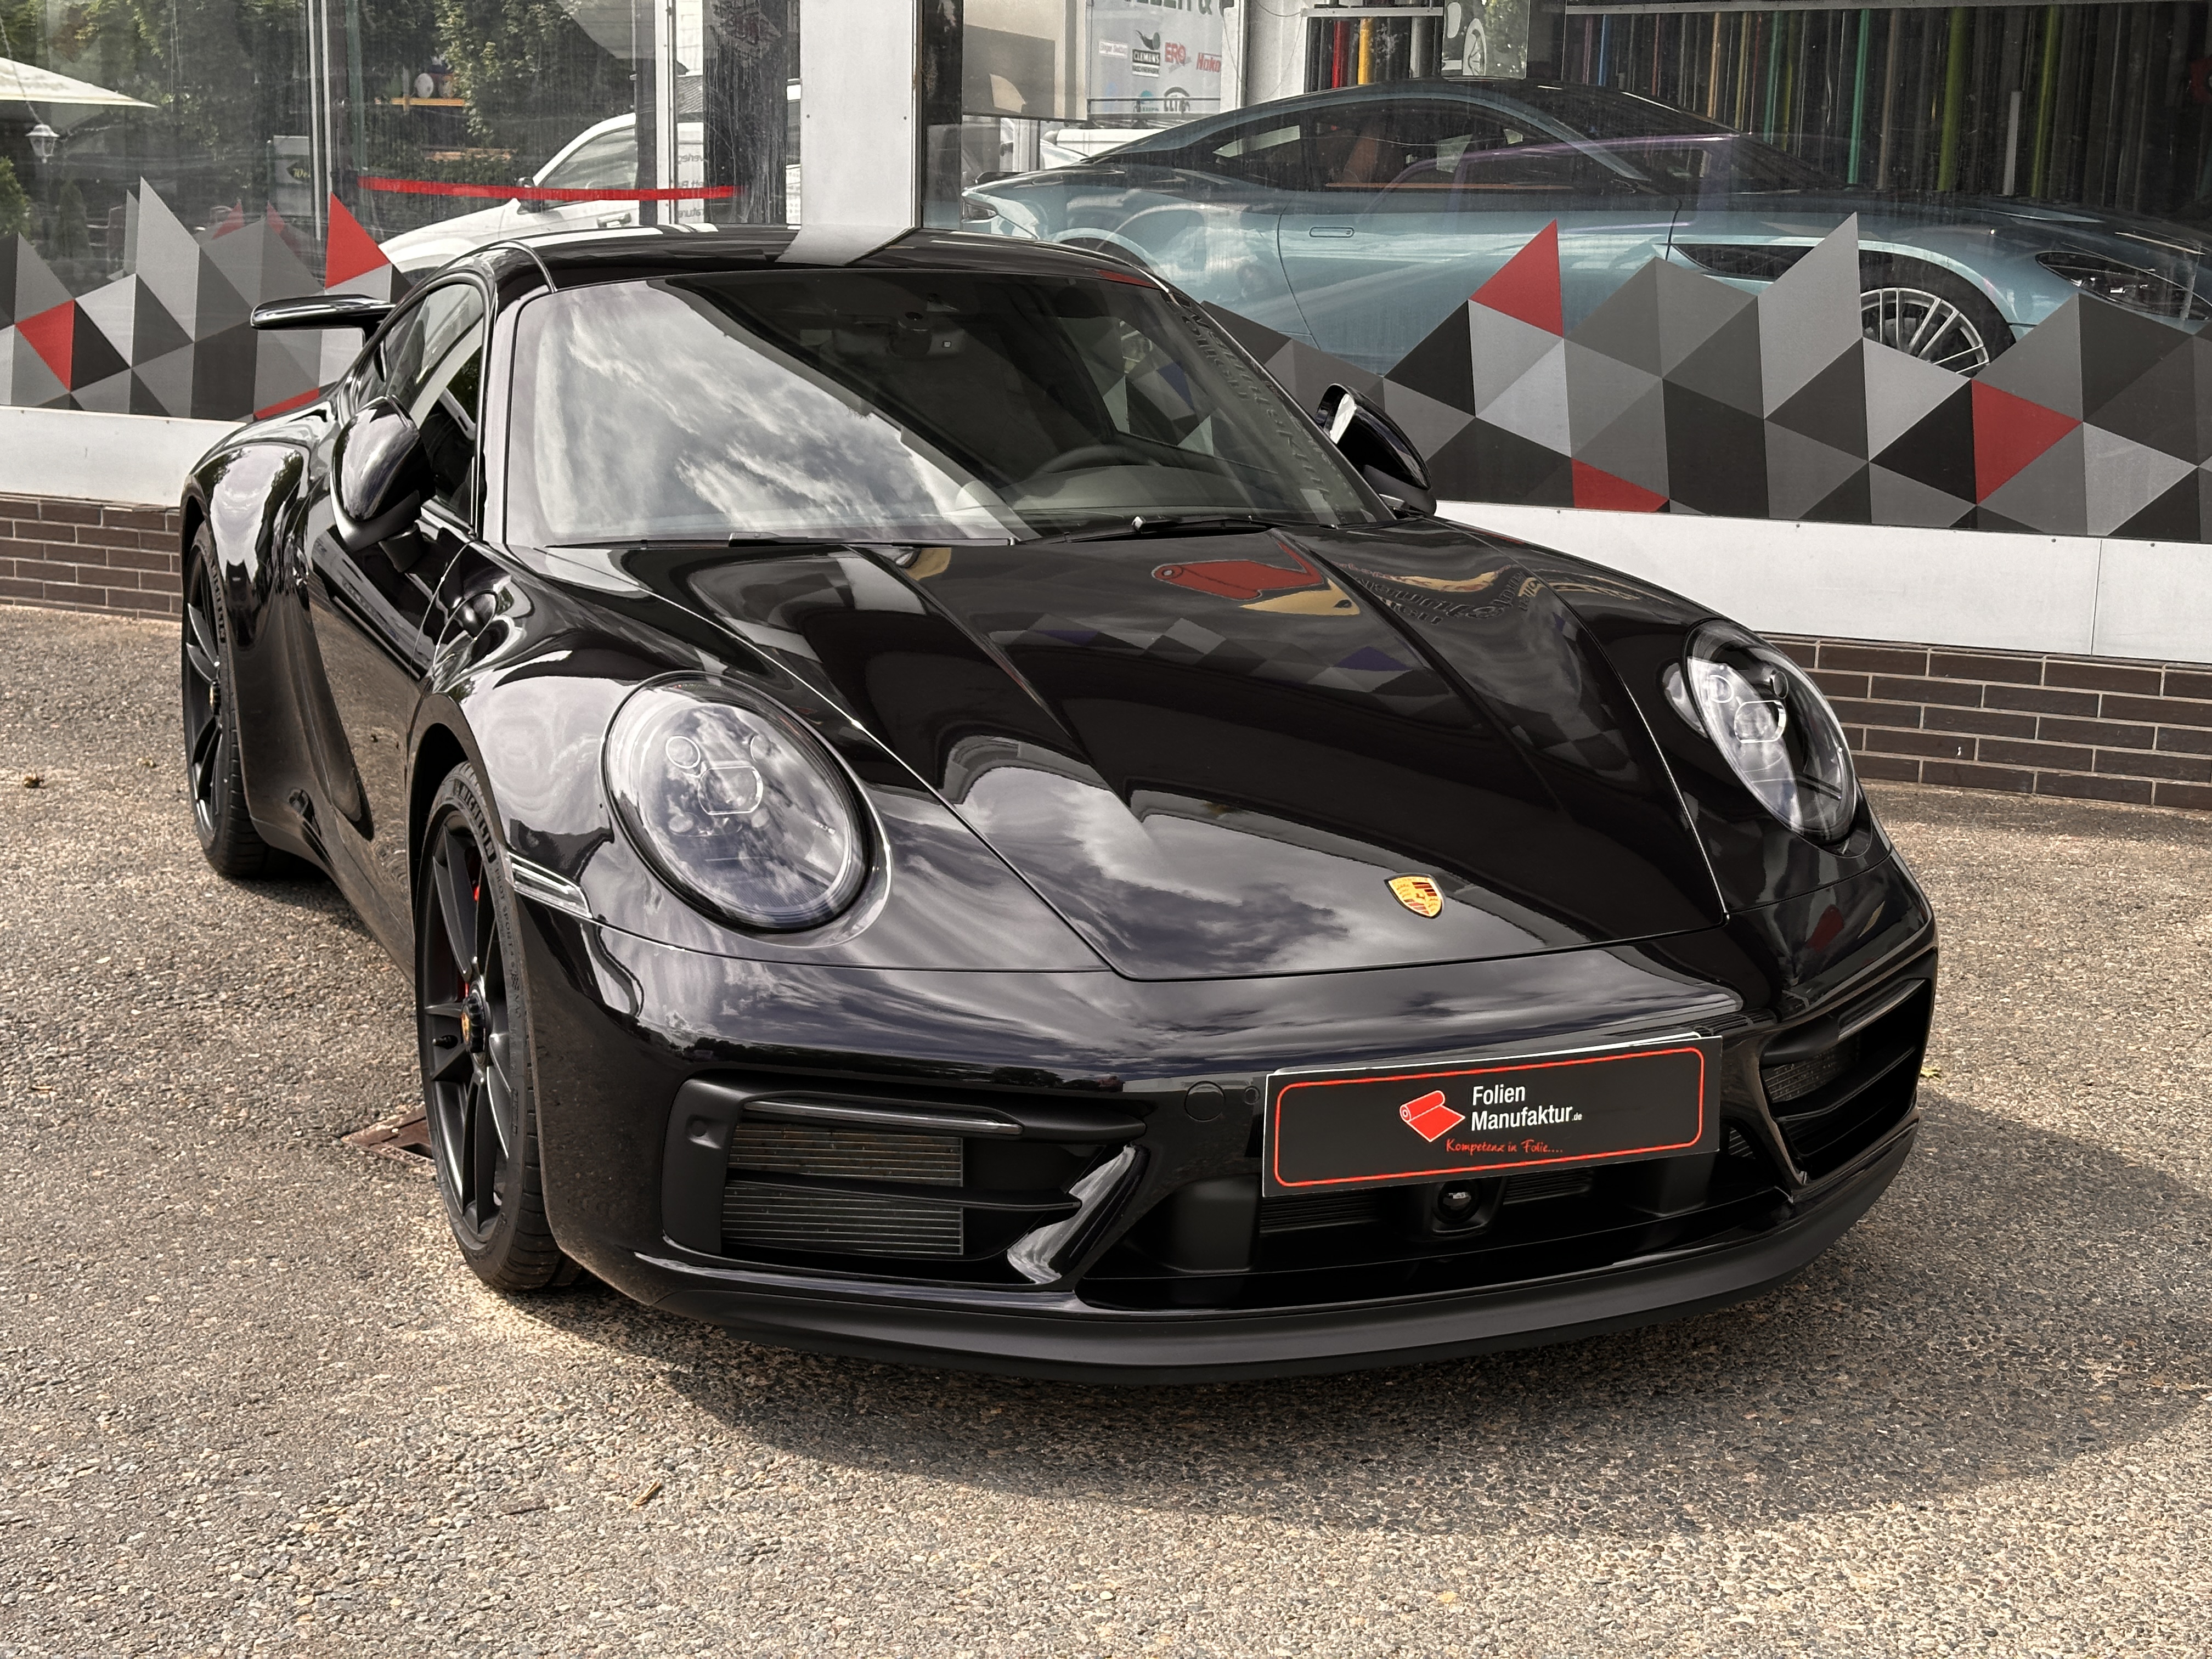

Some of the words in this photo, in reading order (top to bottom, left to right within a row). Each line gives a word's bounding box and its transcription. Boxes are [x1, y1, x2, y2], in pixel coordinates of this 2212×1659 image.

[1133, 51, 1159, 64] CLEMENS
[1165, 42, 1186, 65] ERO
[495, 868, 505, 900] PILOT
[503, 905, 513, 948] SPORT
[1472, 1084, 1525, 1105] Folien
[1446, 1138, 1504, 1156] Kompetenz
[1508, 1141, 1517, 1152] in
